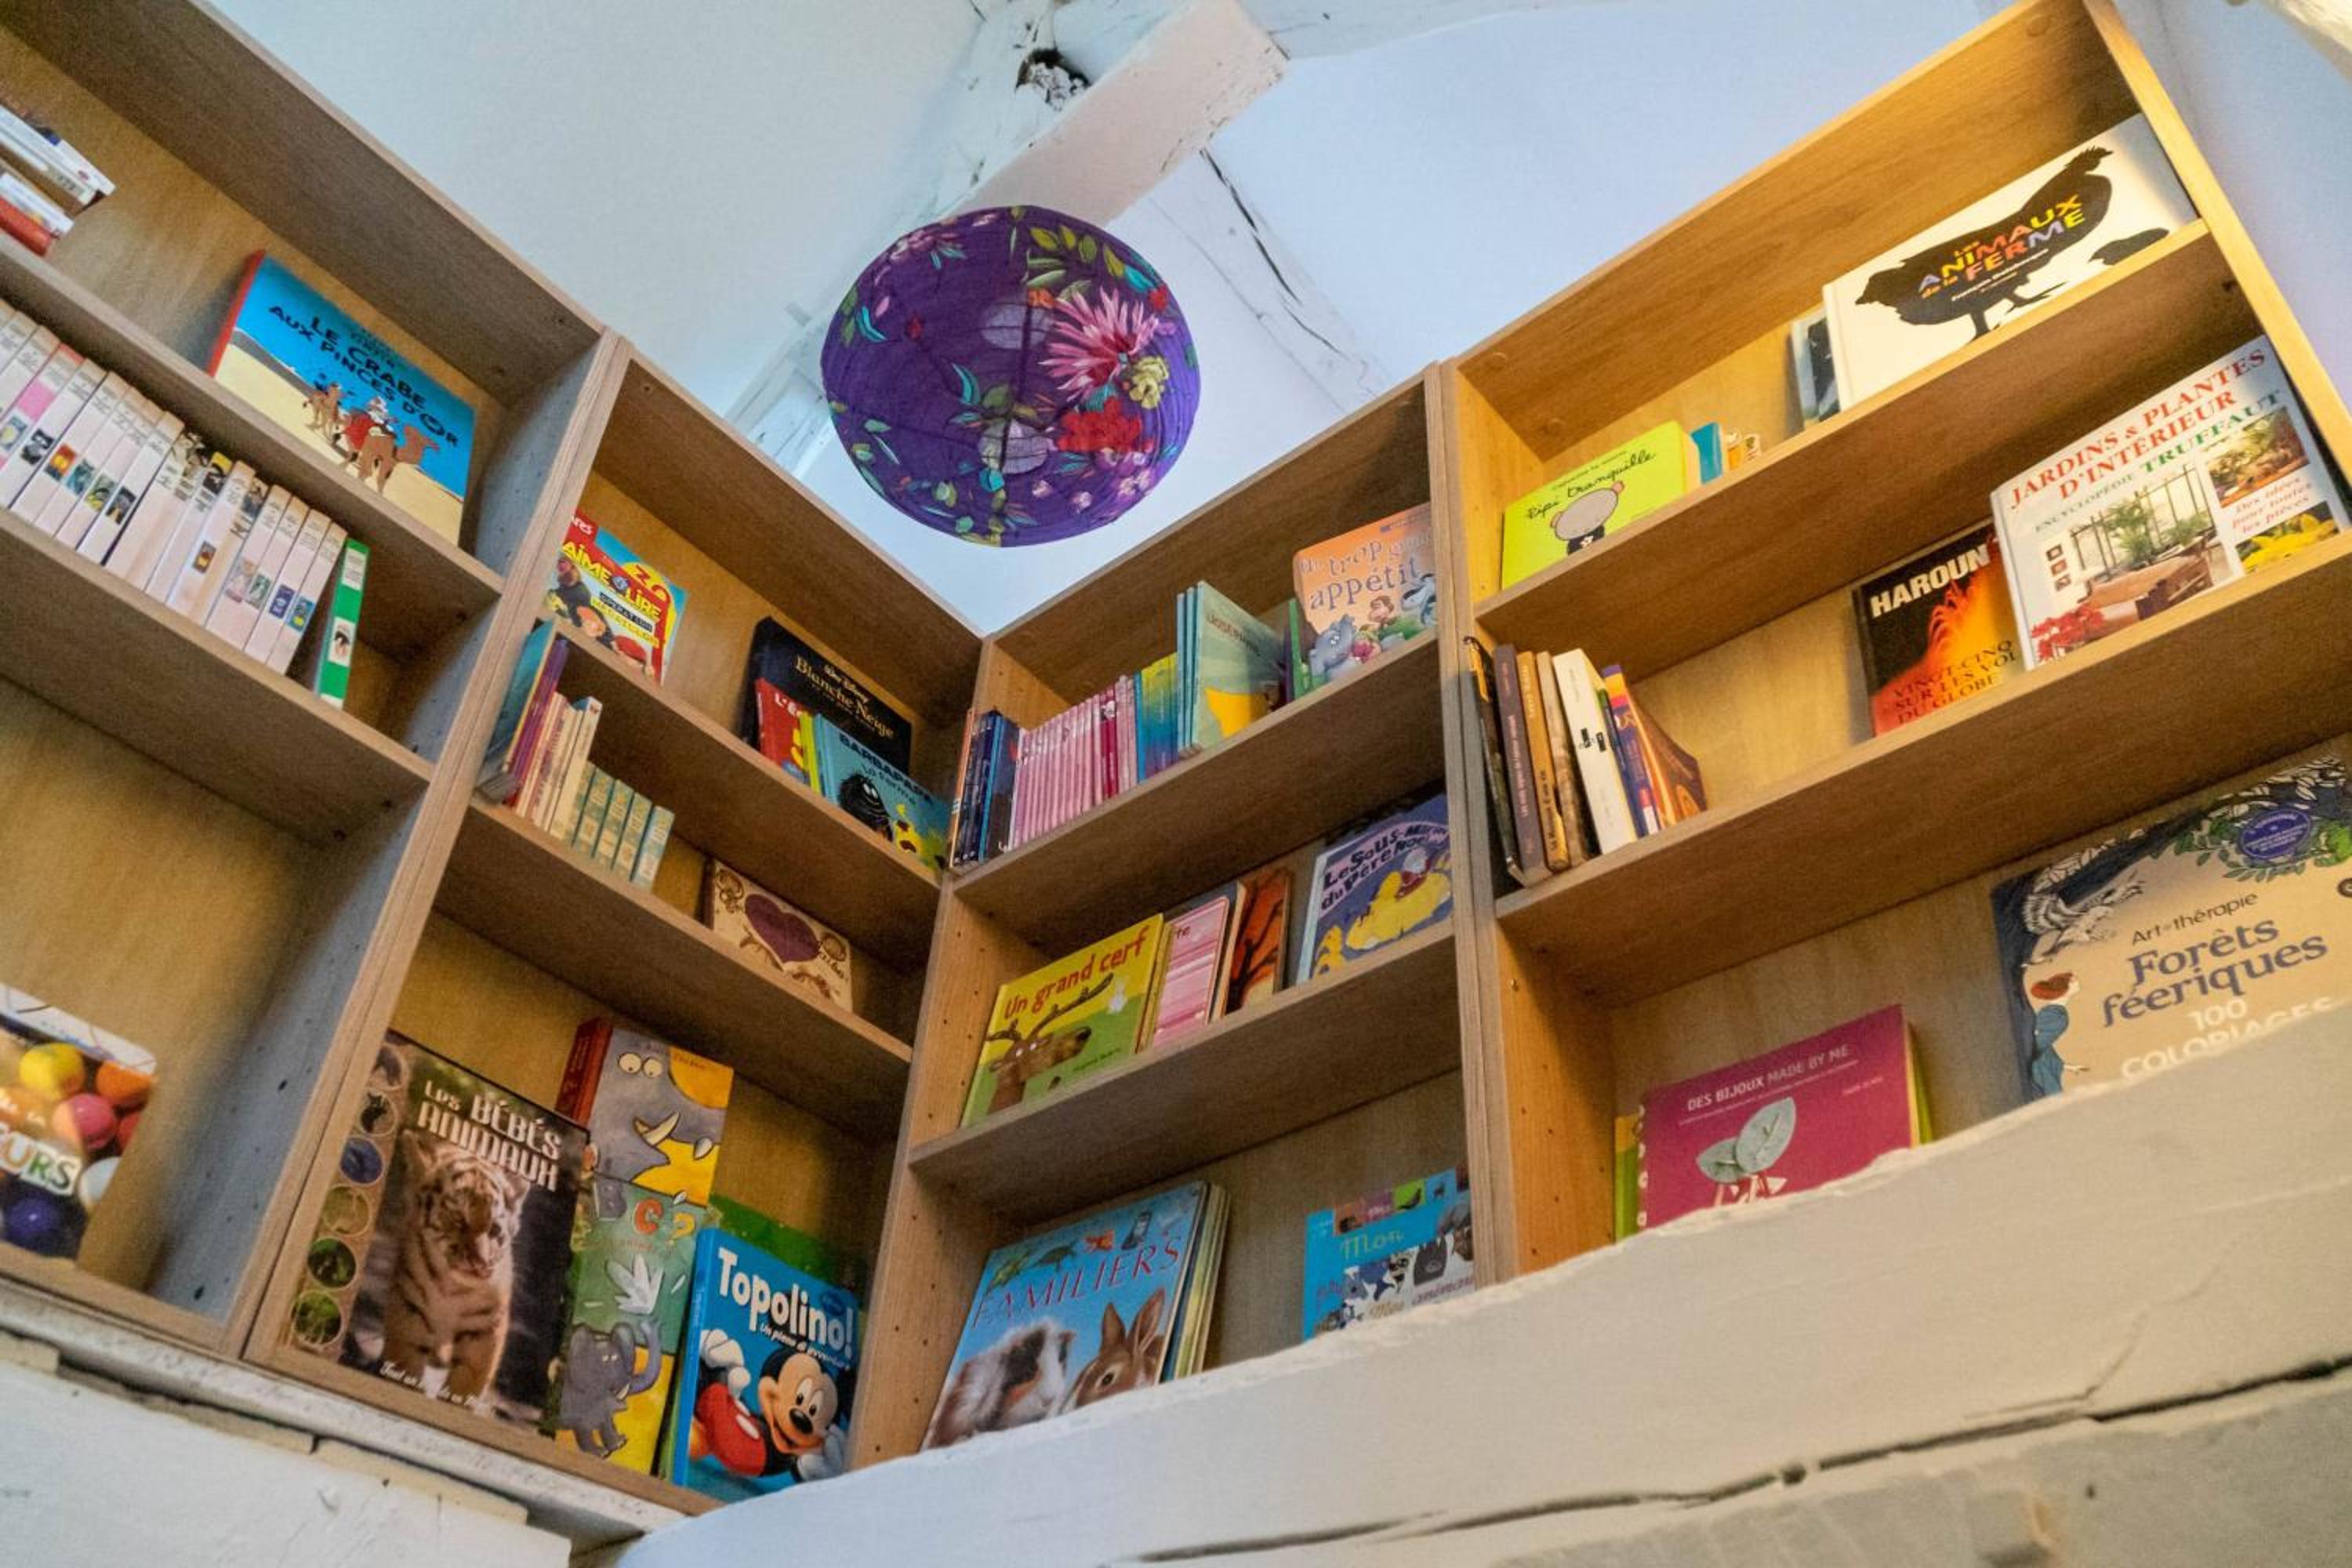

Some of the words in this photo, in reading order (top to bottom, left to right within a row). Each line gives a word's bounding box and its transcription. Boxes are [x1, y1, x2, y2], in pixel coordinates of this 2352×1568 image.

[1918, 194, 2083, 292] ANIMAUX
[1965, 209, 2086, 282] FERME
[269, 305, 314, 343] AUX
[320, 339, 396, 403] PINCES
[402, 400, 459, 448] D'OR
[310, 316, 339, 343] LE
[347, 346, 428, 408] CRABE
[2010, 430, 2120, 510] JARDINS
[2123, 424, 2139, 440] &
[2142, 349, 2267, 428] PLANTES
[2058, 390, 2238, 501] D'INTÉRIEUR
[2142, 389, 2280, 473] TRUFFAUT
[1309, 556, 1419, 612] appétit
[1870, 543, 1991, 619] HAROUN
[1894, 687, 1933, 710] SUR
[1896, 706, 1926, 725] DU
[1321, 887, 1344, 910] du
[1343, 848, 1392, 892] Père
[1323, 862, 1350, 891] Le
[2128, 917, 2280, 988] Forêts
[2130, 891, 2259, 947] Art-thérapie
[1004, 996, 1028, 1020] Un
[1030, 952, 1096, 1014] grand
[1098, 924, 1151, 972] cerf
[2102, 934, 2329, 1029] féeriques
[2187, 996, 2249, 1033] 100
[1686, 1093, 1714, 1113] DES
[1715, 1074, 1766, 1104] BIJOUX
[1766, 1061, 1806, 1085] MADE
[1807, 1051, 1826, 1070] BY
[1828, 1044, 1850, 1063] ME
[470, 1094, 562, 1162] BÉBÉS
[972, 1232, 1183, 1331] FAMILIERS
[1341, 1229, 1405, 1261] Mon
[717, 1246, 855, 1360] Topolino!
